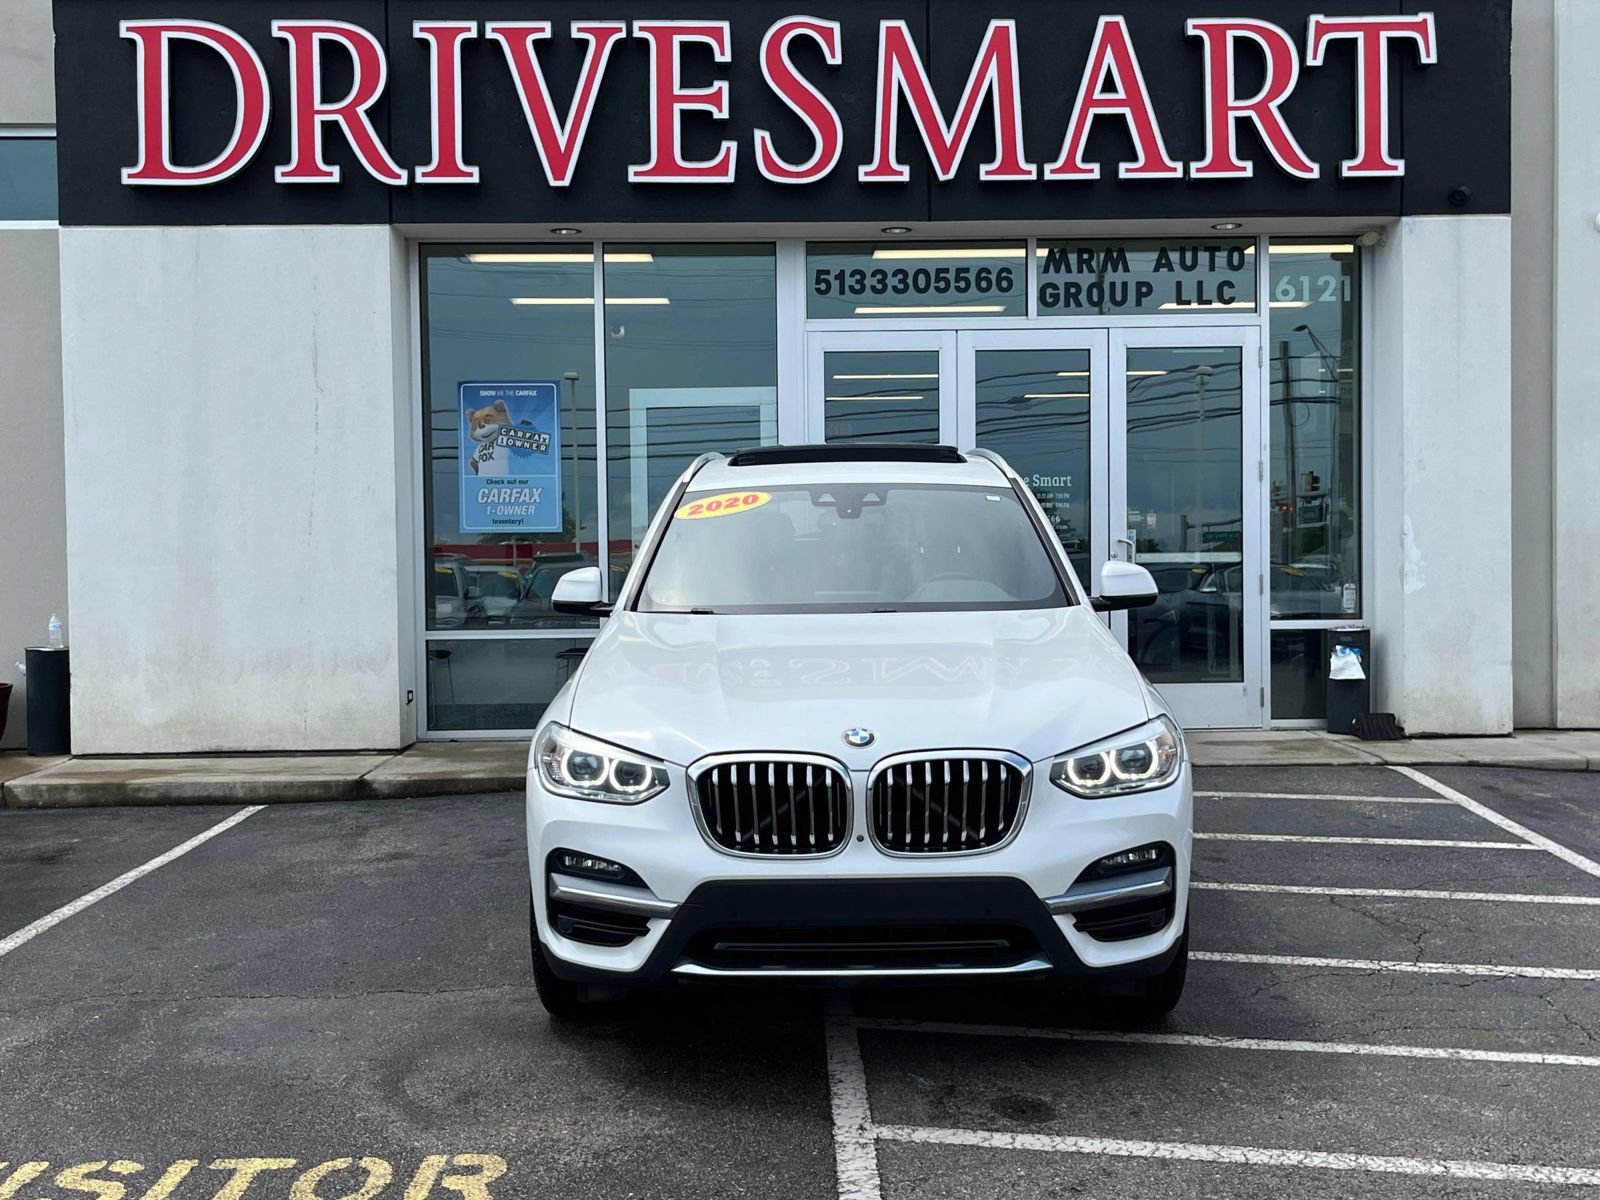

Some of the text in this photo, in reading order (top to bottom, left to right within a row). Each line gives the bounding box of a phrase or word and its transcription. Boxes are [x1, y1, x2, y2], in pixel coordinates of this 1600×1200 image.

[119, 12, 1437, 187] DRIVESMART
[1042, 246, 1246, 274] MRM AUTO
[814, 267, 1014, 296] 5133305566
[1275, 275, 1351, 302] 6121
[1039, 280, 1236, 308] GROUP LLC
[500, 428, 550, 444] CARFAX
[479, 441, 495, 453] CAR
[478, 451, 495, 463] FOX
[1032, 474, 1072, 486] Smart
[477, 487, 543, 504] CARFAX
[687, 494, 760, 516] 2020
[486, 505, 536, 516] 1-OWNER
[492, 518, 524, 526] Inventory!
[0, 1153, 507, 1200] ISITOR
